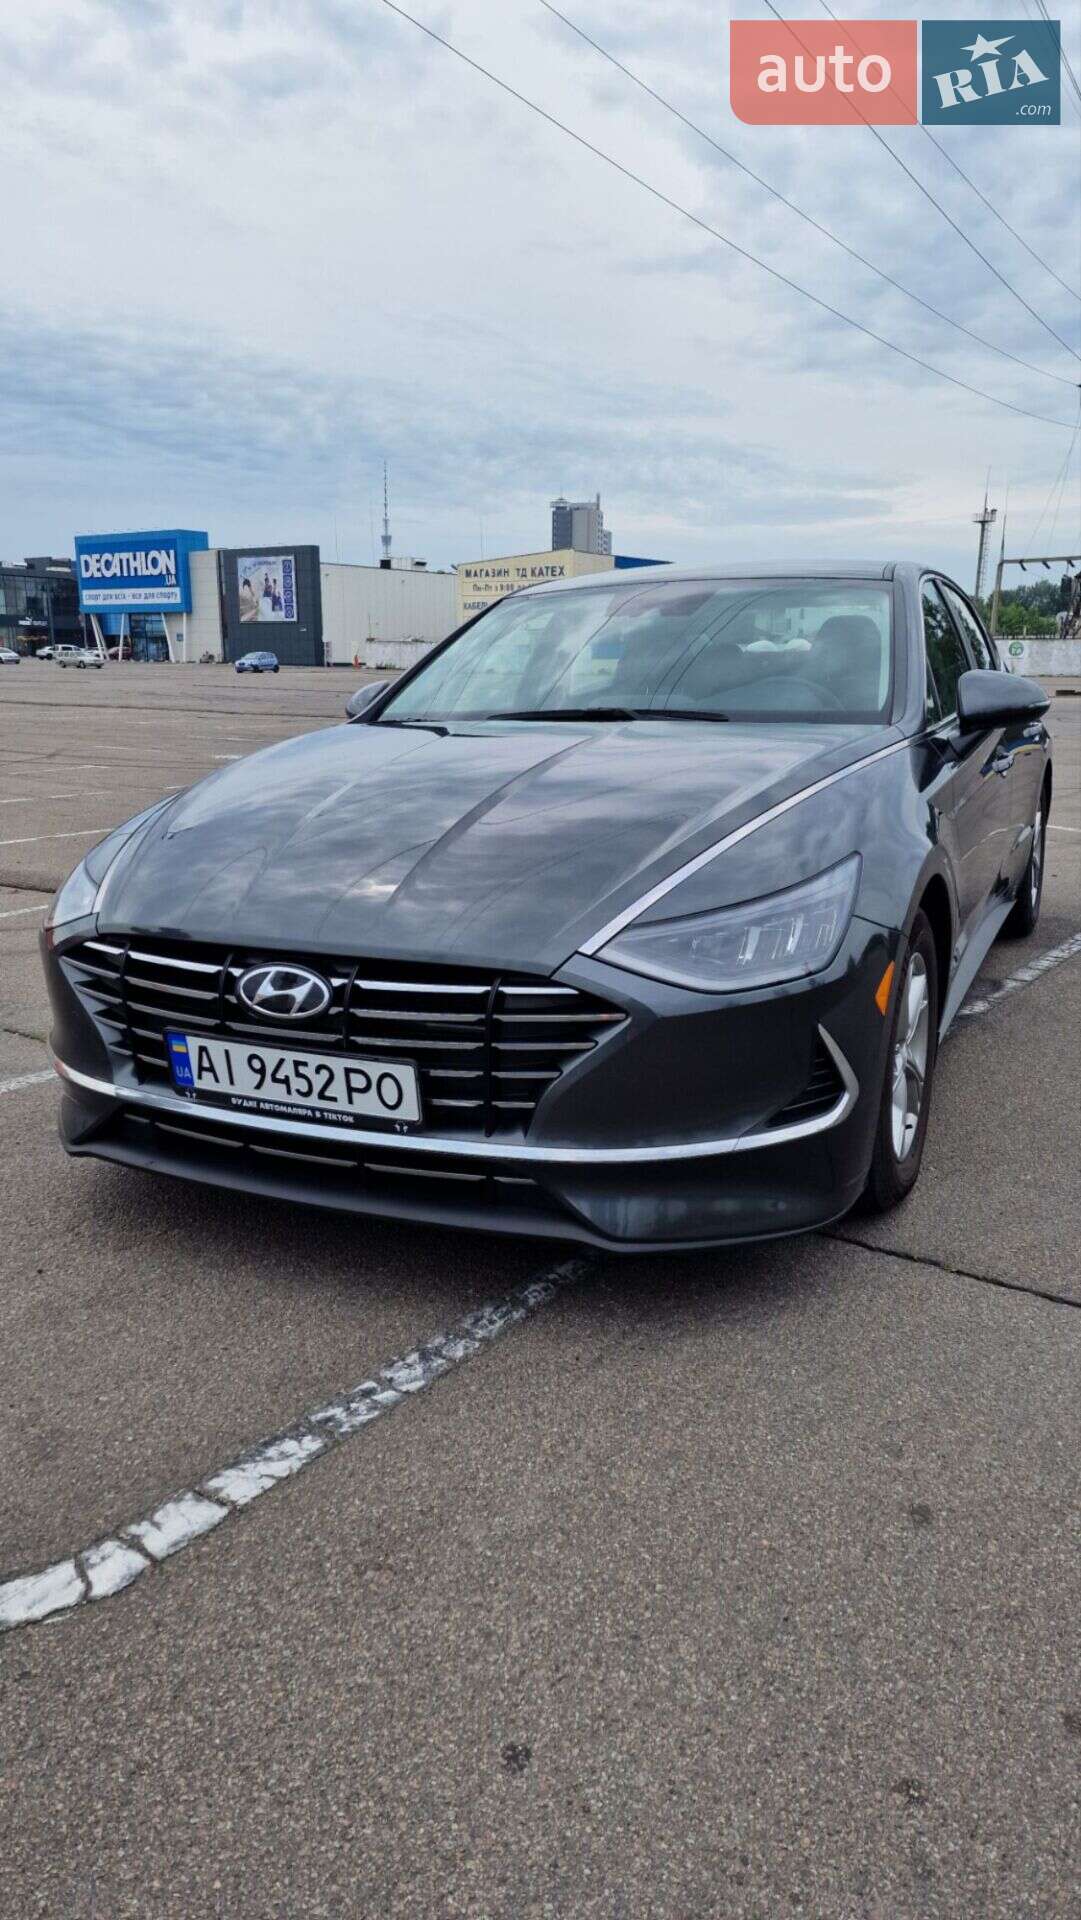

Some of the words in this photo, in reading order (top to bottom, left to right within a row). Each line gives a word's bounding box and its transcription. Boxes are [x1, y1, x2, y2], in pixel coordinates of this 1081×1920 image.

[80, 549, 176, 578] DECATHLON
[465, 567, 509, 578] МАГАЗИН
[516, 567, 527, 577] ТД
[176, 1066, 192, 1079] UA
